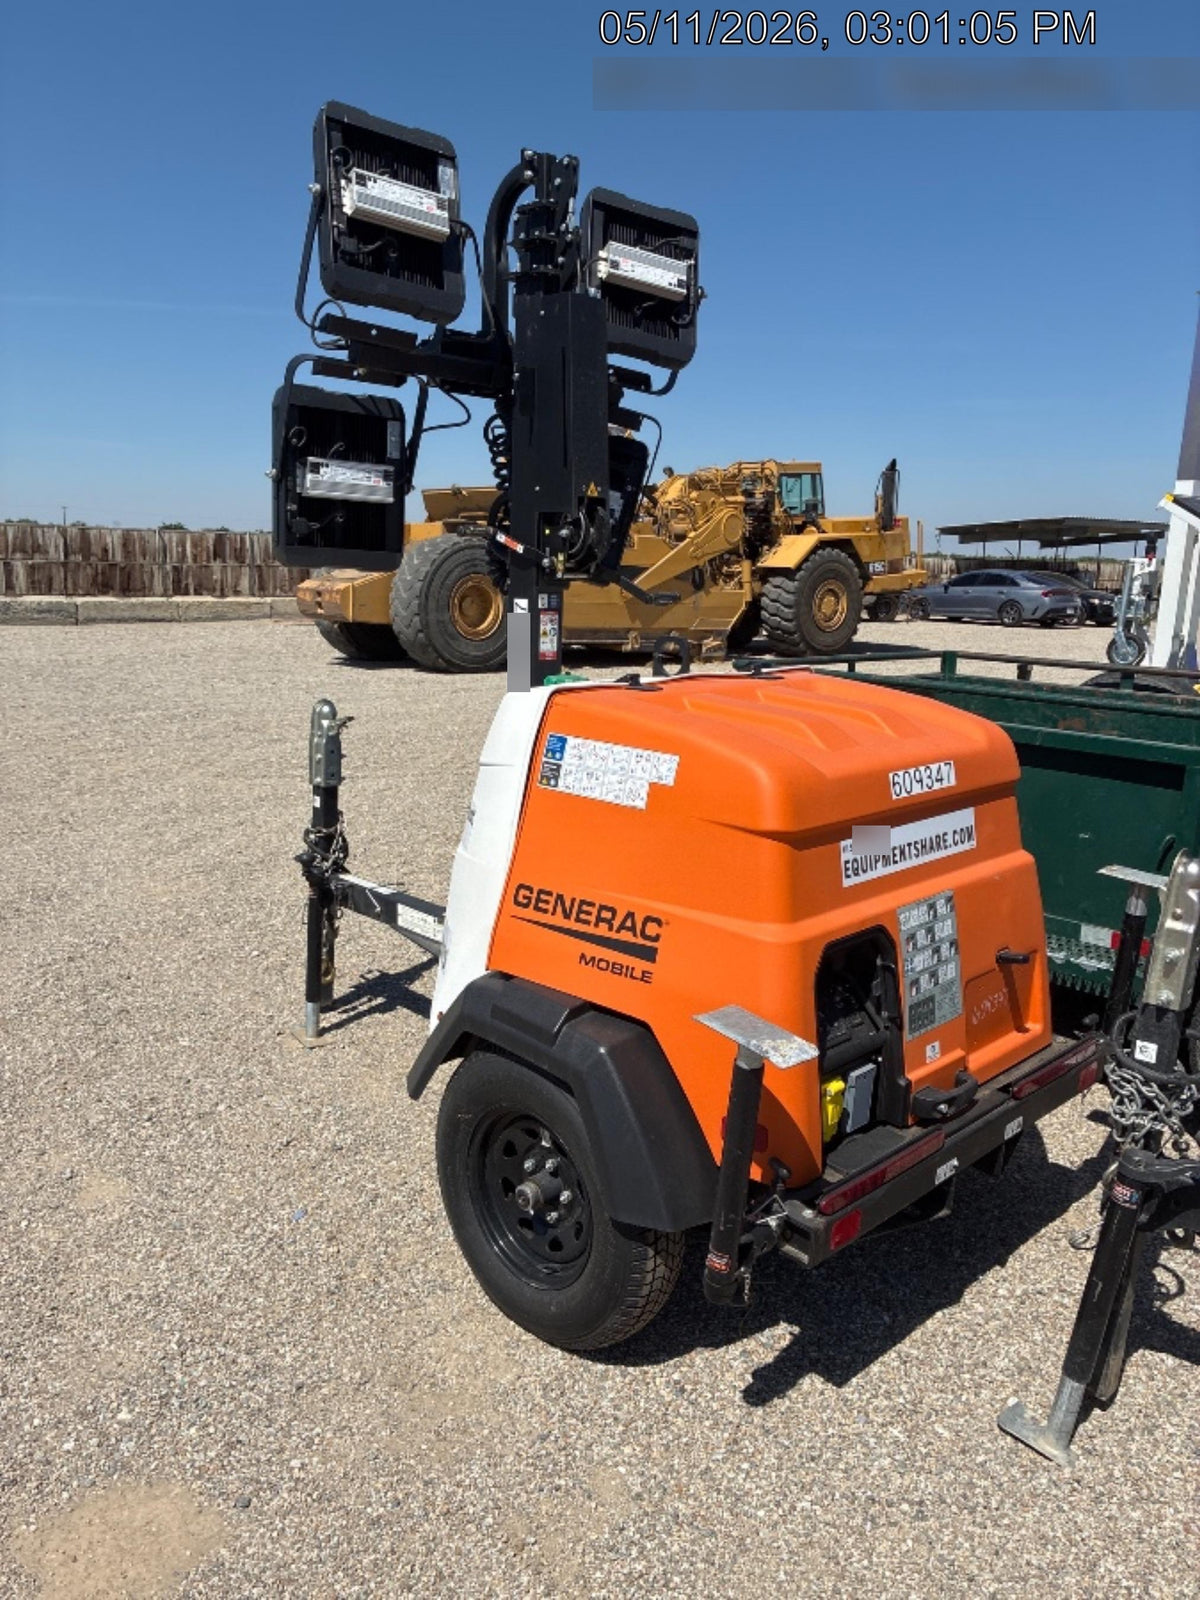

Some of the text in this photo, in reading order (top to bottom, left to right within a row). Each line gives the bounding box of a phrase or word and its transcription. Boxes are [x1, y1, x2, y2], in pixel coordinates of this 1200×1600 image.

[892, 762, 952, 797] 609347
[844, 824, 975, 879] EQUIPMENTSHARE.COM
[513, 883, 663, 943] GENERAC
[579, 953, 653, 984] MOBILE
